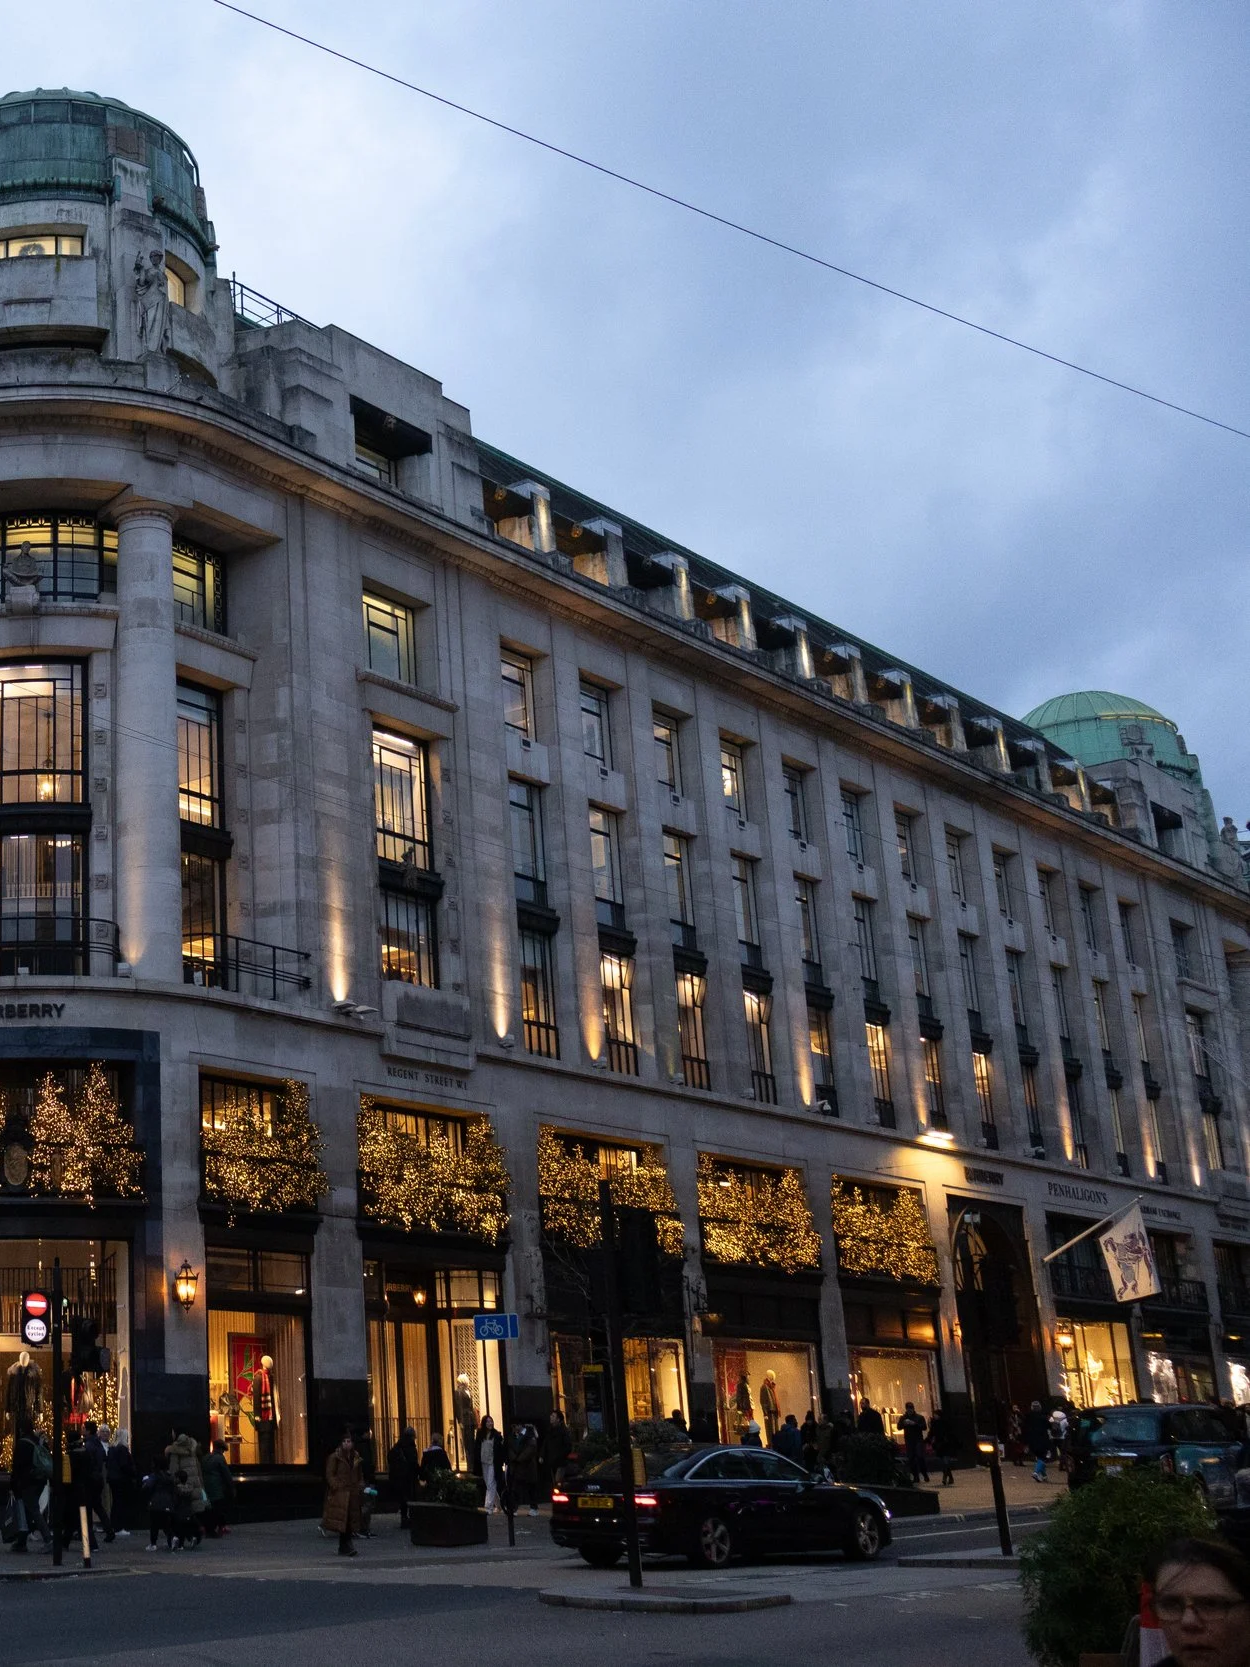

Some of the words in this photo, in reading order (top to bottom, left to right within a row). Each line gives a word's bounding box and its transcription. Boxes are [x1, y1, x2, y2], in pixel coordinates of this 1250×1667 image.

[387, 1066, 418, 1081] REGENT
[424, 1073, 453, 1088] STREET
[1047, 1182, 1108, 1206] PENHALIGON'S
